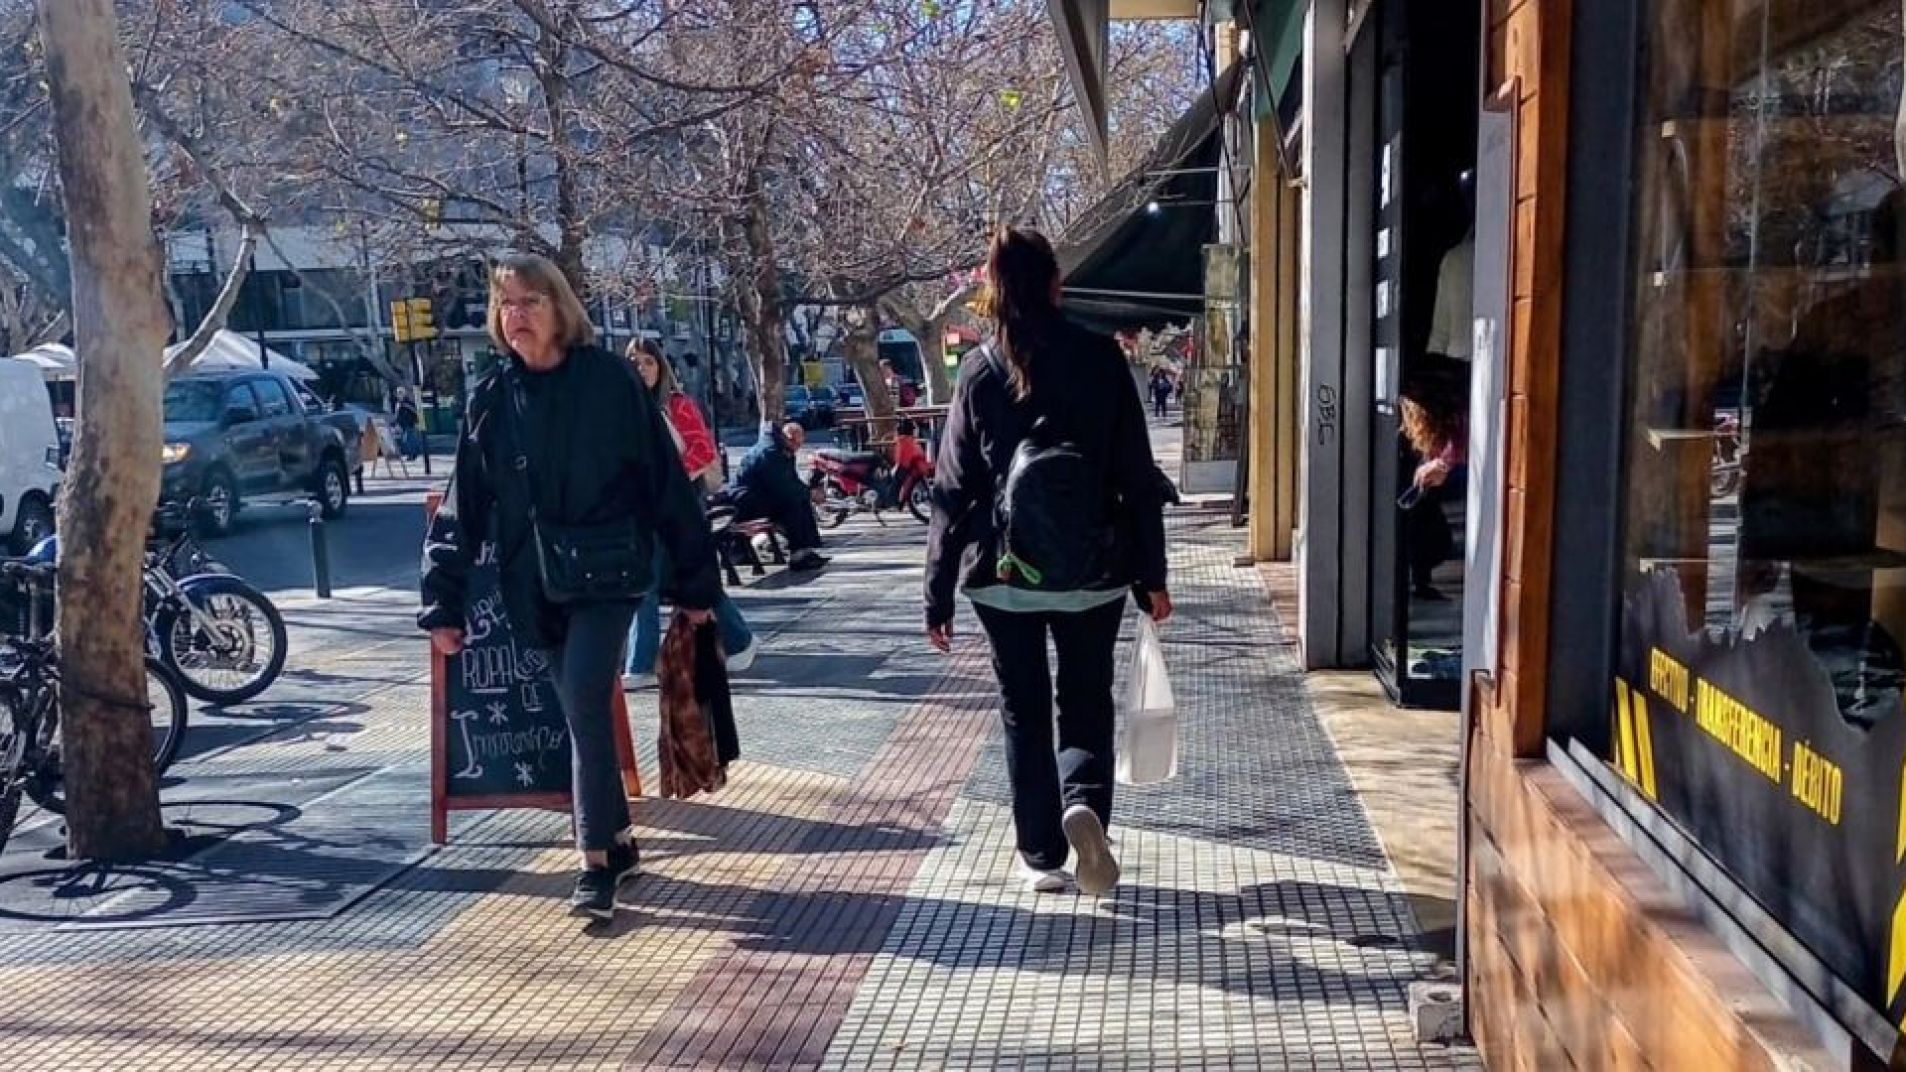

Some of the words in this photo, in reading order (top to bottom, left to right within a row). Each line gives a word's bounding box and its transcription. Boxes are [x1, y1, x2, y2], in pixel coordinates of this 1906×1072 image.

[463, 647, 514, 688] ROPA
[1696, 676, 1782, 784] TRANSFERENCIA
[1793, 739, 1841, 825] DÉBITO
